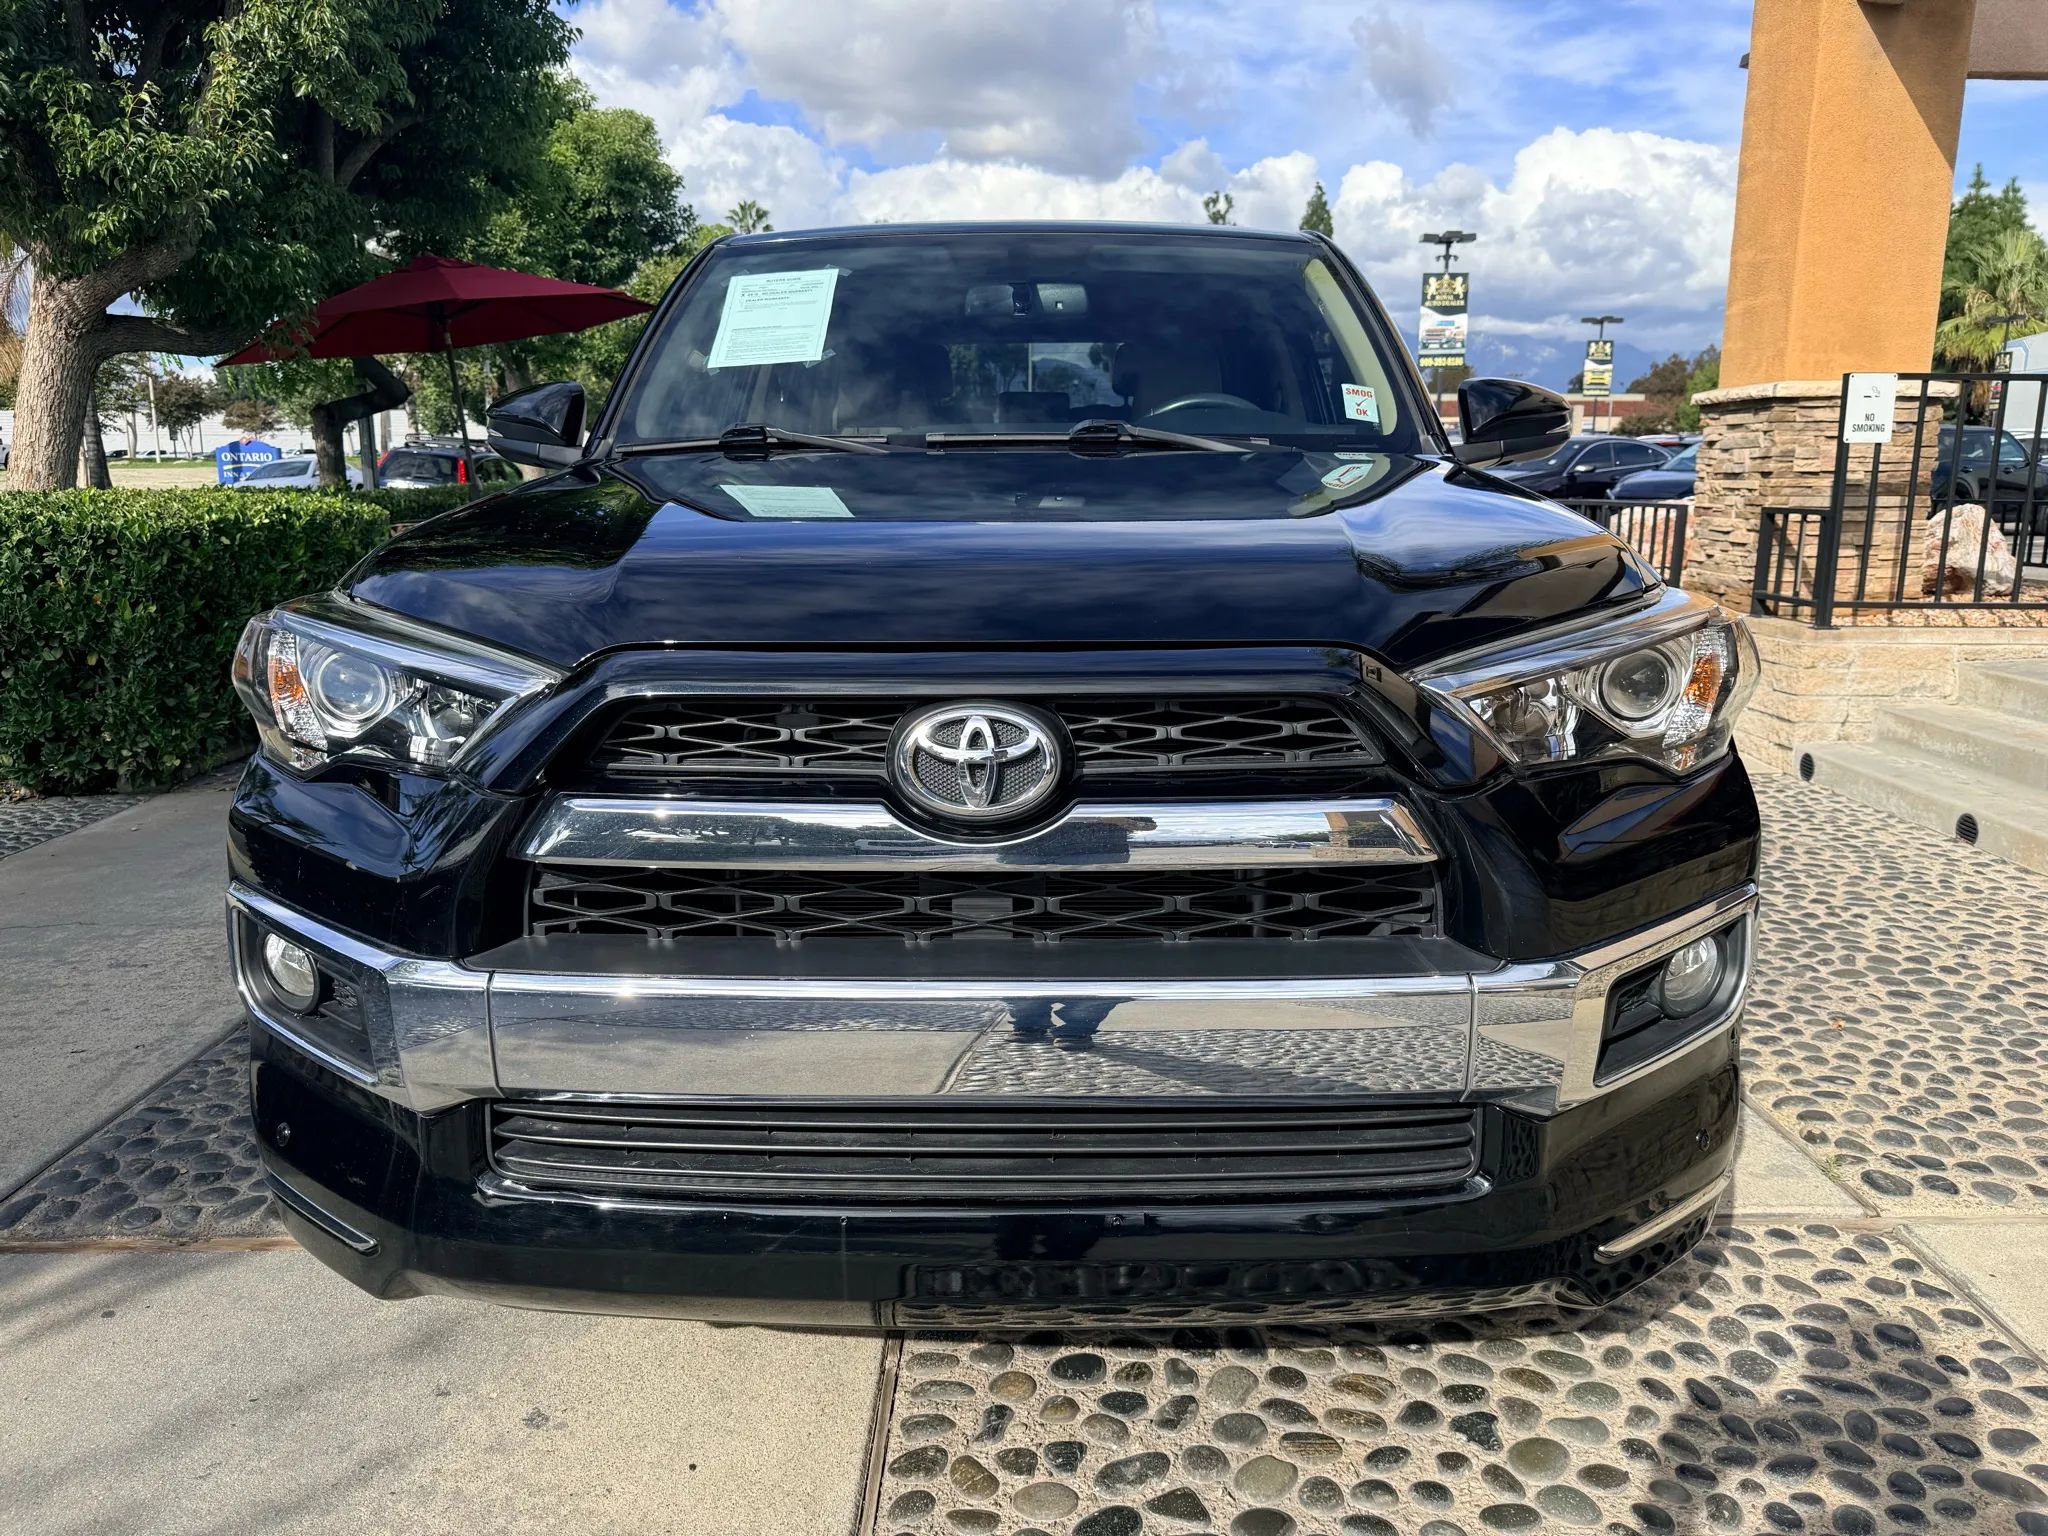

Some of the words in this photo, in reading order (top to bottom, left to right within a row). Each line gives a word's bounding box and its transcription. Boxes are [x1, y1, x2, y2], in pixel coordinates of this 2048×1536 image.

[1345, 387, 1373, 398] SMOG
[1356, 408, 1369, 417] OK
[1864, 413, 1875, 421] NO
[1852, 424, 1885, 432] SMOKING
[221, 453, 273, 462] ONTARIO
